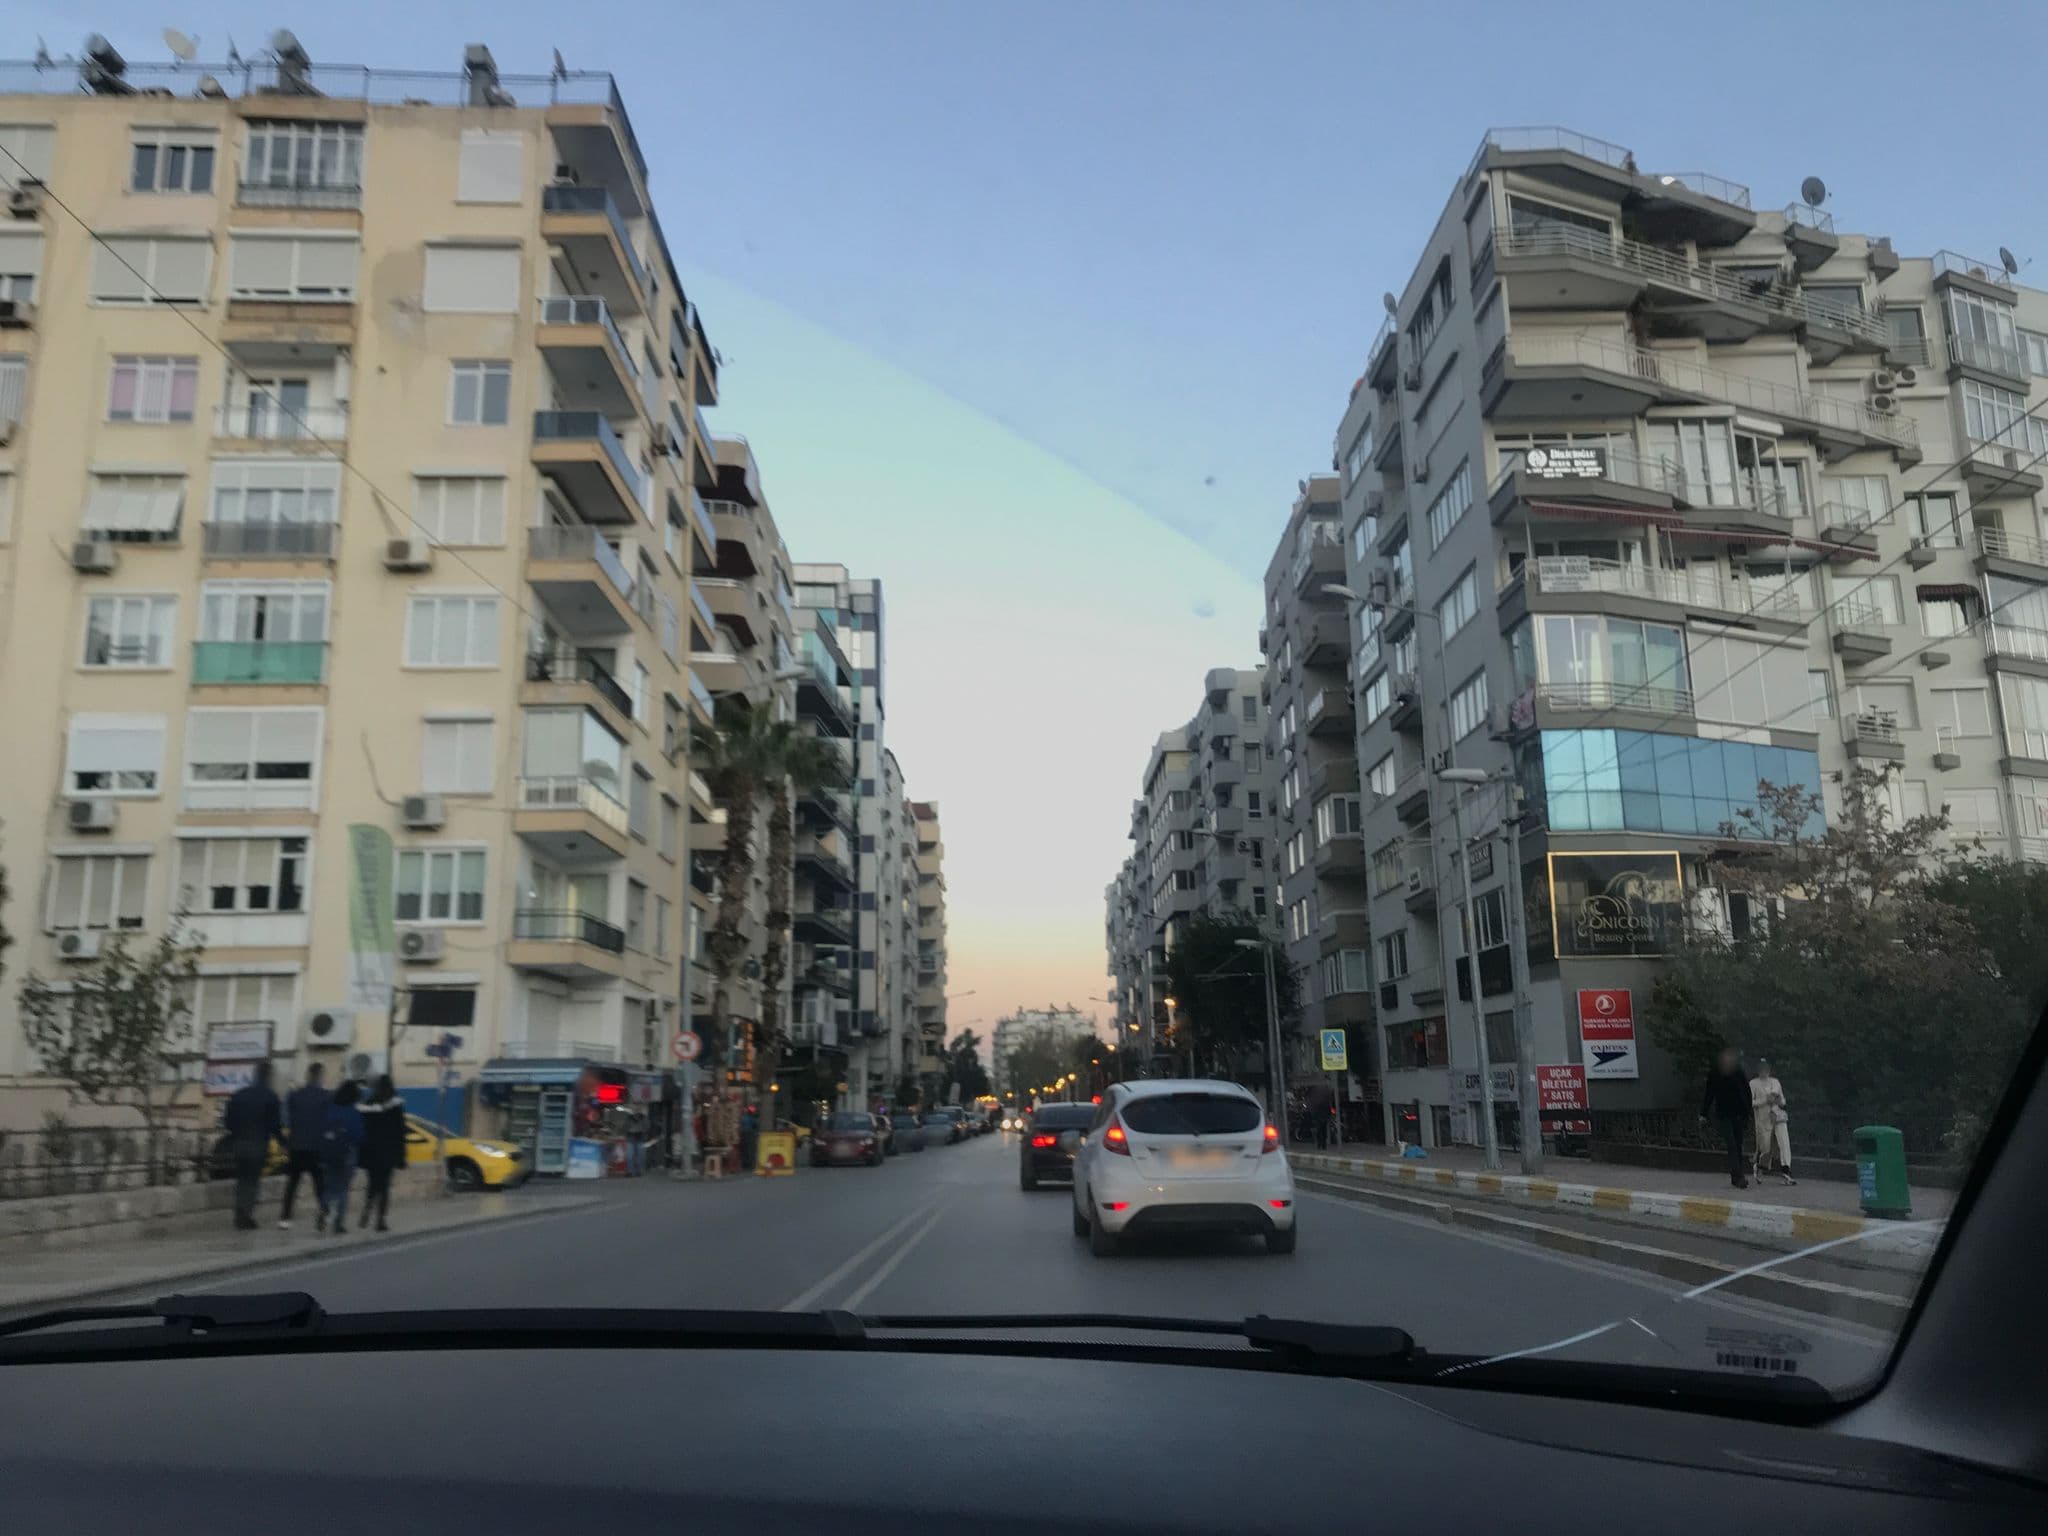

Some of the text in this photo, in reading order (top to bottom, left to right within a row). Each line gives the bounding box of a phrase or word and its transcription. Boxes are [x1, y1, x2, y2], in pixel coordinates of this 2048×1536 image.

[1550, 1068, 1572, 1080] UÇAK
[1542, 1078, 1582, 1089] BİLETLERİ
[1551, 1090, 1575, 1102] SATIŞ
